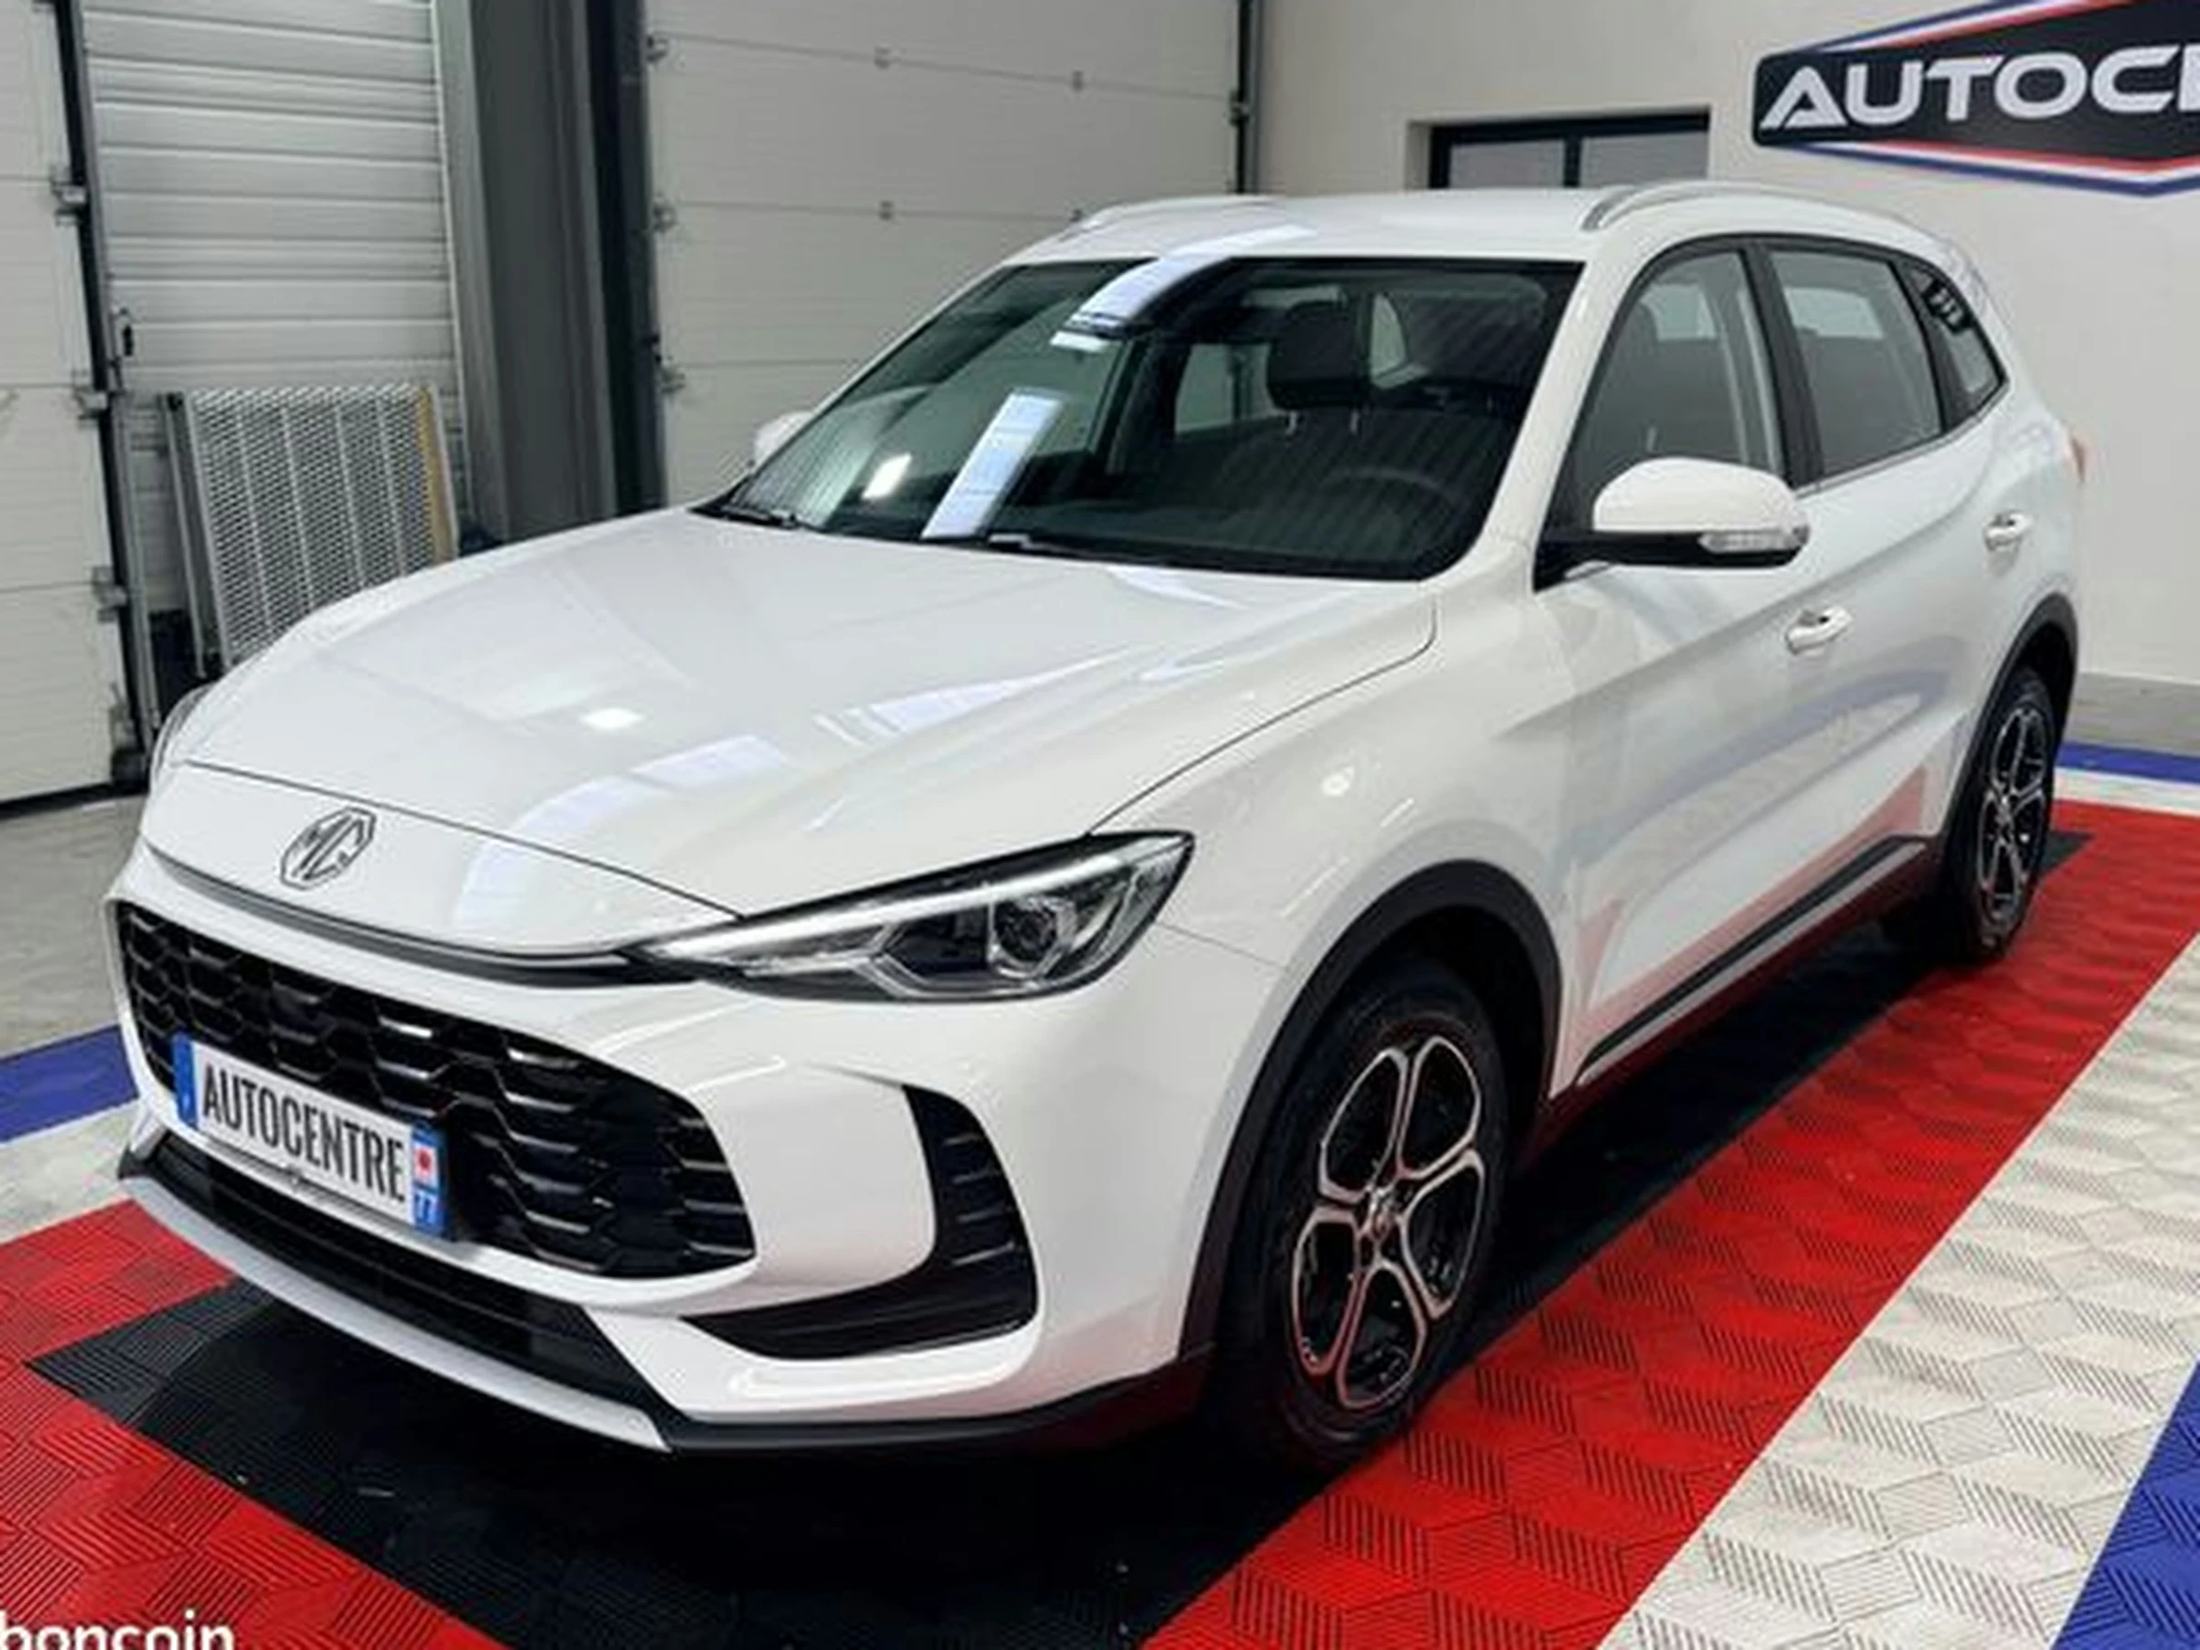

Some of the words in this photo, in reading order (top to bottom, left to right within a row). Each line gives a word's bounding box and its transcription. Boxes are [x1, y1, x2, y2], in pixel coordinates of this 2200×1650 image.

[1759, 46, 2200, 131] AUTOC
[285, 811, 367, 883] MG
[203, 1062, 405, 1202] AUTOCENTRE
